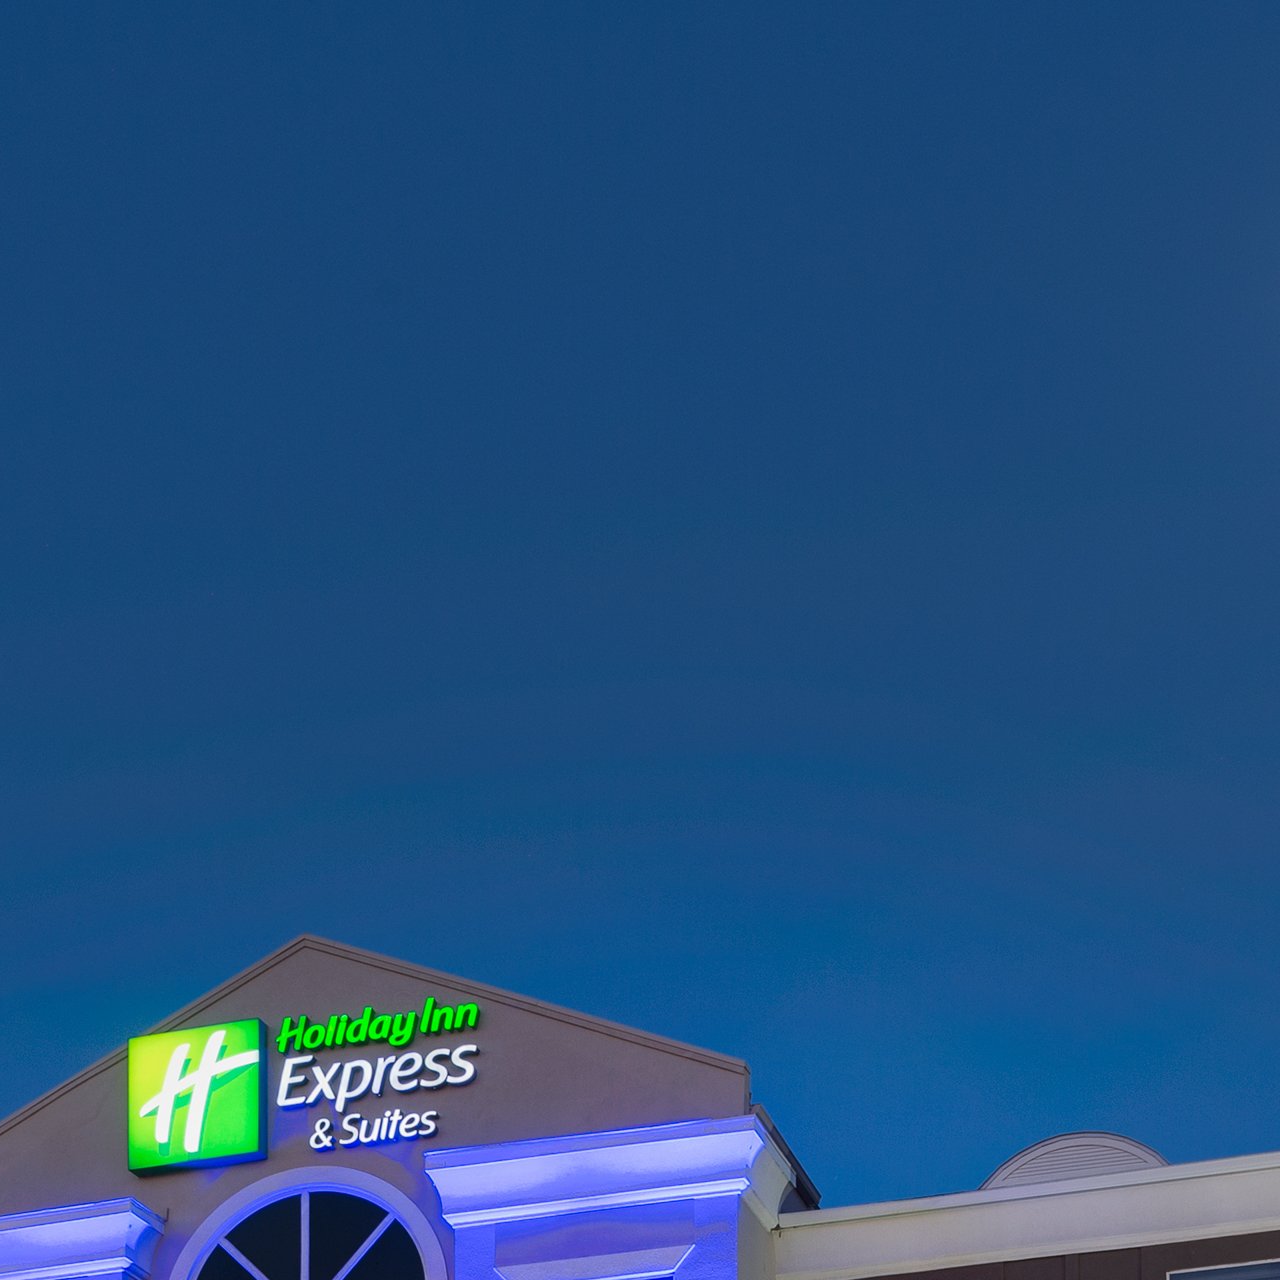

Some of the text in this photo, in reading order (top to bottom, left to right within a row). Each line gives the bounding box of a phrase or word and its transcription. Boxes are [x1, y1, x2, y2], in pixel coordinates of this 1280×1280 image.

[276, 996, 479, 1053] Holiday Inn
[276, 1044, 478, 1114] Express
[309, 1109, 438, 1150] & Suites
